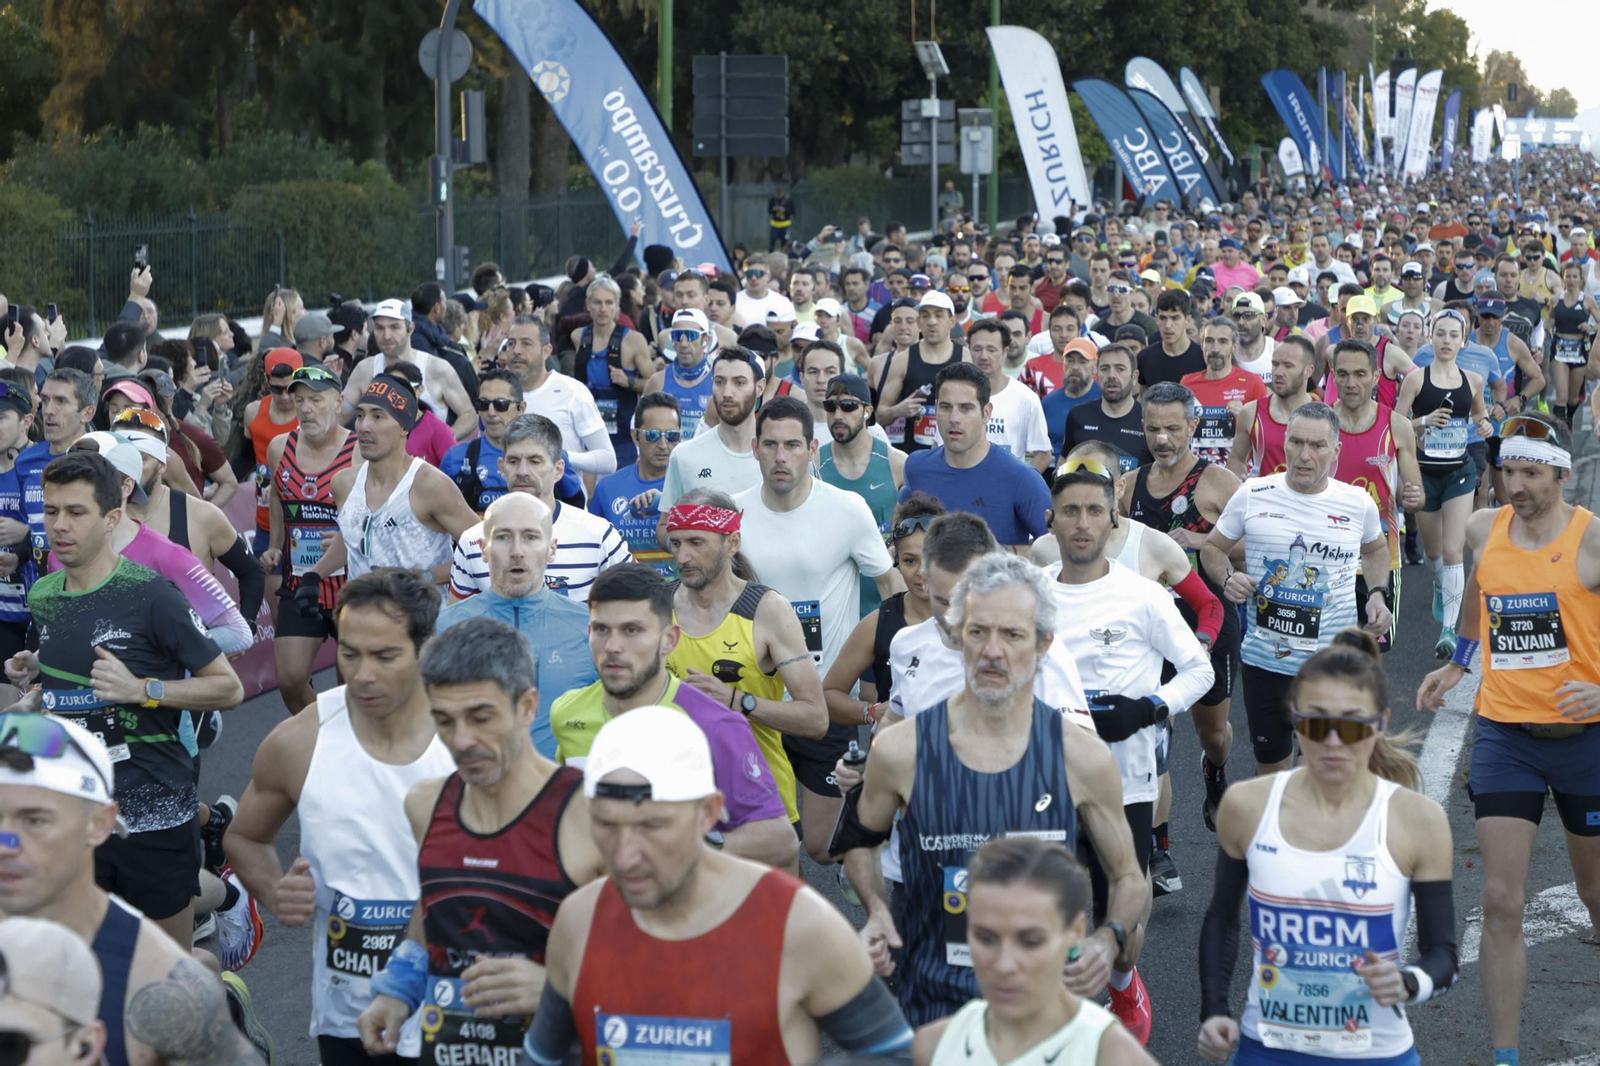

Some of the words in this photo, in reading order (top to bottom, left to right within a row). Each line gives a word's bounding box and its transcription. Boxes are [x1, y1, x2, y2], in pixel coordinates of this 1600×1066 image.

[1202, 429, 1223, 437] FELIX
[300, 555, 323, 564] ANG
[1277, 590, 1315, 603] ZURICH
[1507, 597, 1549, 609] ZURICH
[1276, 607, 1297, 618] 3656
[1267, 616, 1305, 635] PAULO
[1510, 620, 1534, 632] 3720
[1498, 633, 1556, 651] SYLVAIN
[362, 906, 412, 920] ZURIC
[1258, 907, 1369, 948] RRCM
[362, 935, 395, 950] 2987
[333, 949, 391, 974] CHAL
[1297, 983, 1329, 997] 7856
[1259, 999, 1370, 1025] VALENTINA
[460, 1023, 496, 1040] 4108
[635, 1024, 712, 1047] ZURICH
